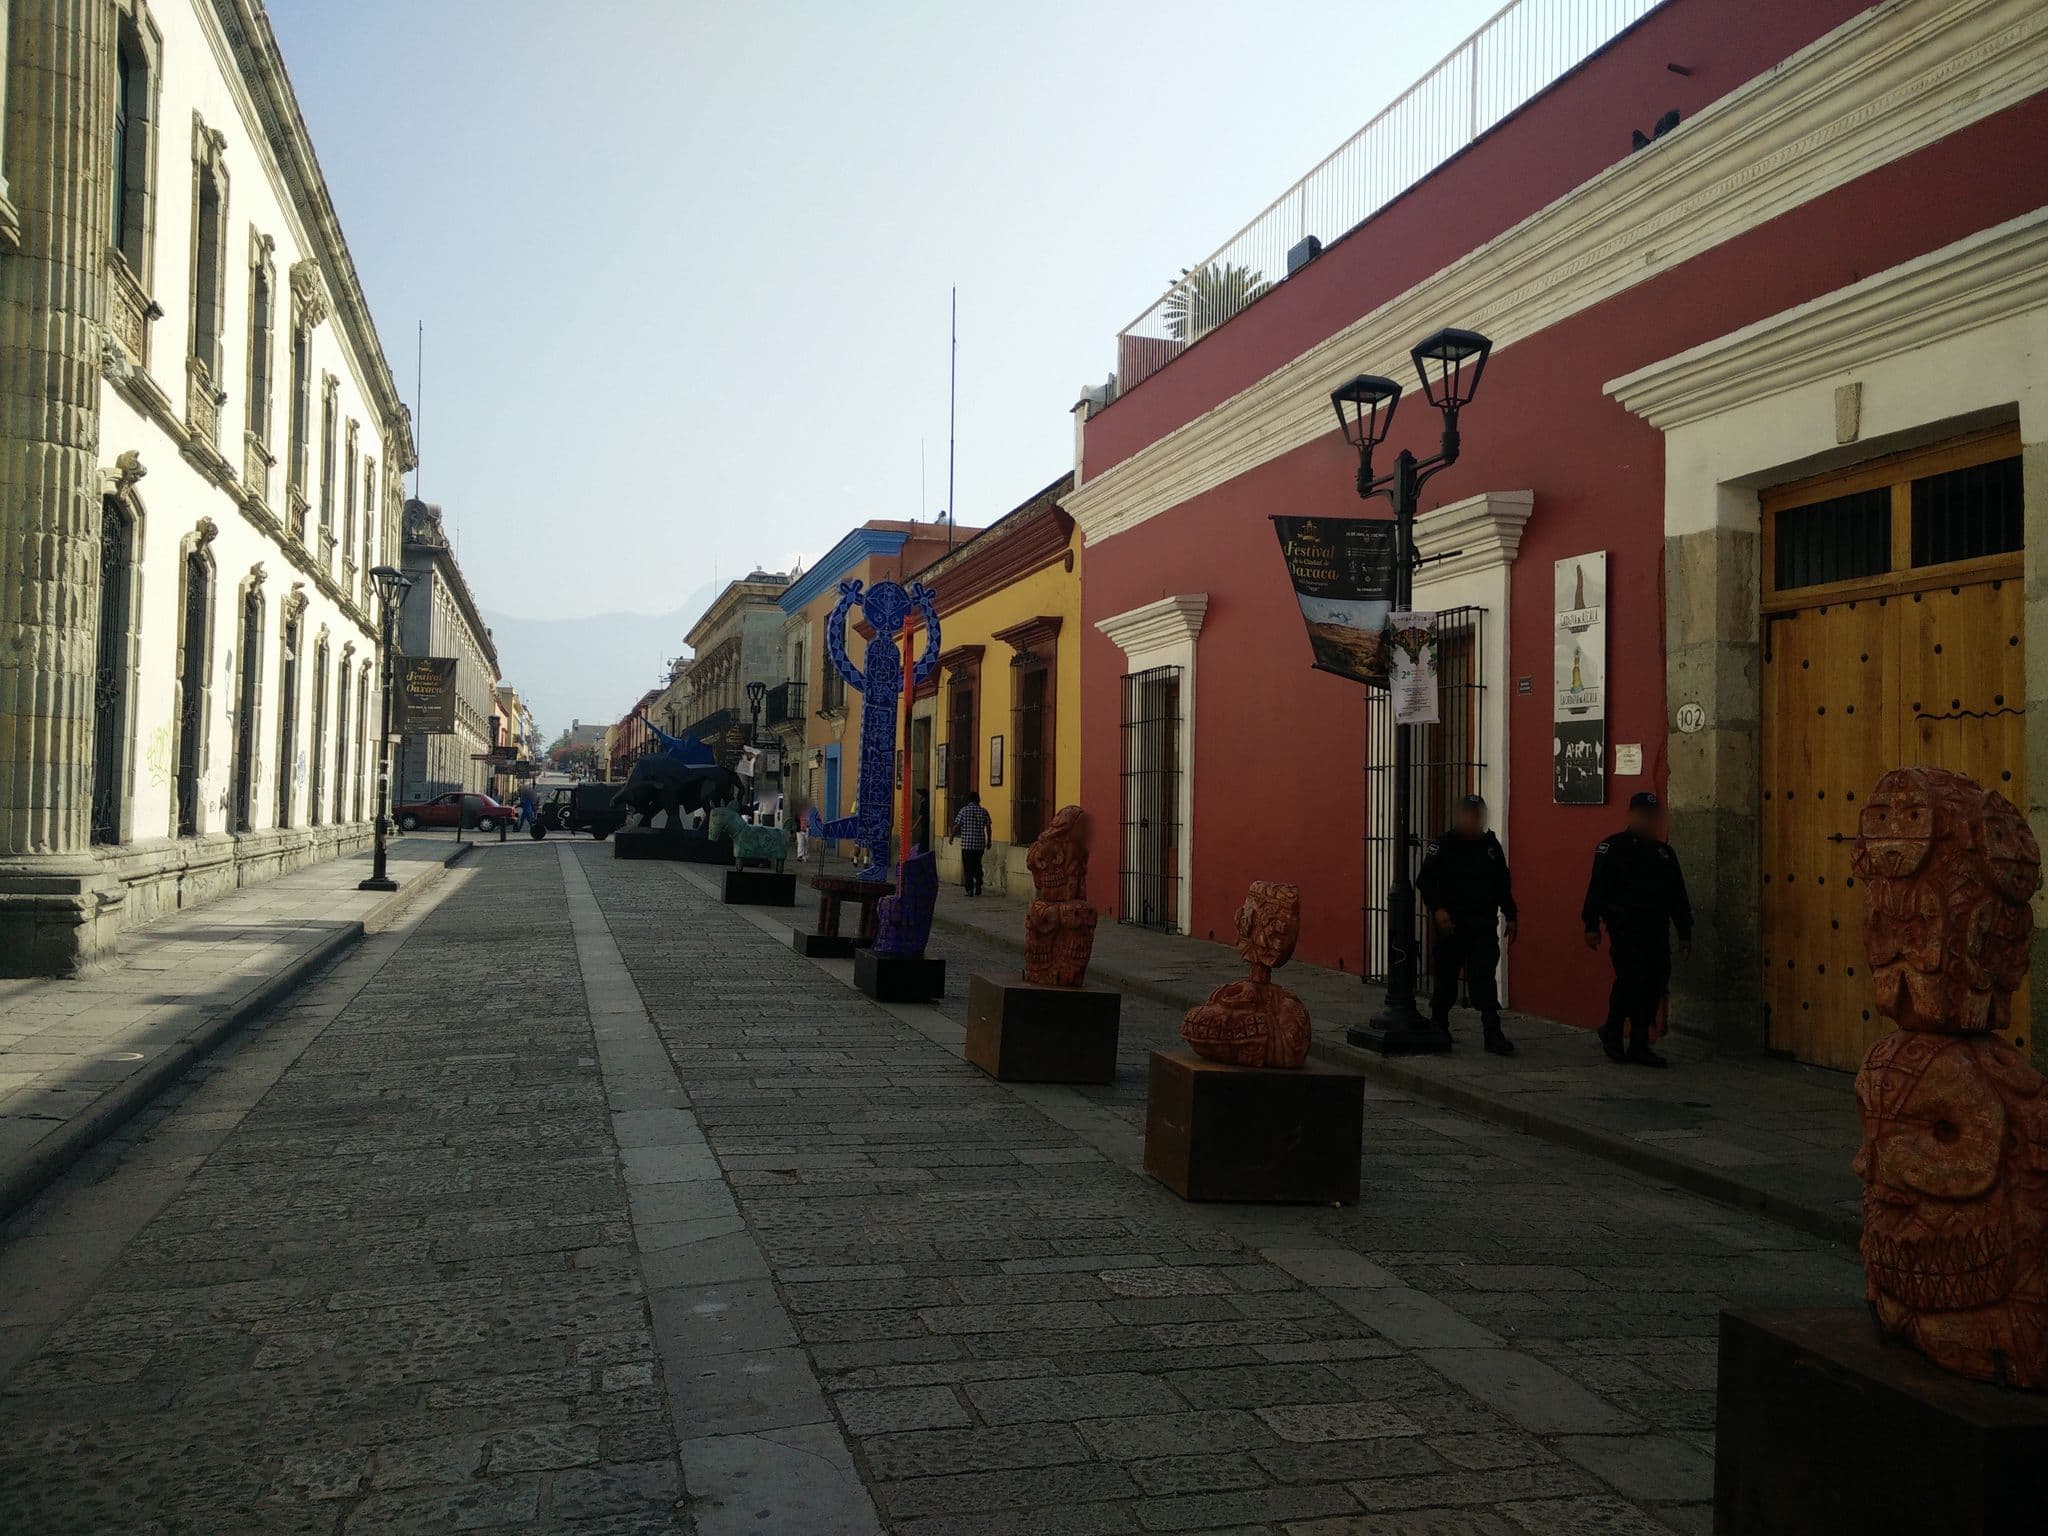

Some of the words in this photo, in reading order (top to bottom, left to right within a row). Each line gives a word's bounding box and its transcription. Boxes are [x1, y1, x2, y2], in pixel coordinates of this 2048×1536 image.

[1284, 541, 1335, 558] Festival
[406, 671, 443, 681] Festival
[407, 683, 444, 693] Oaxaca
[1680, 708, 1702, 728] 102
[1566, 743, 1591, 758] ART
